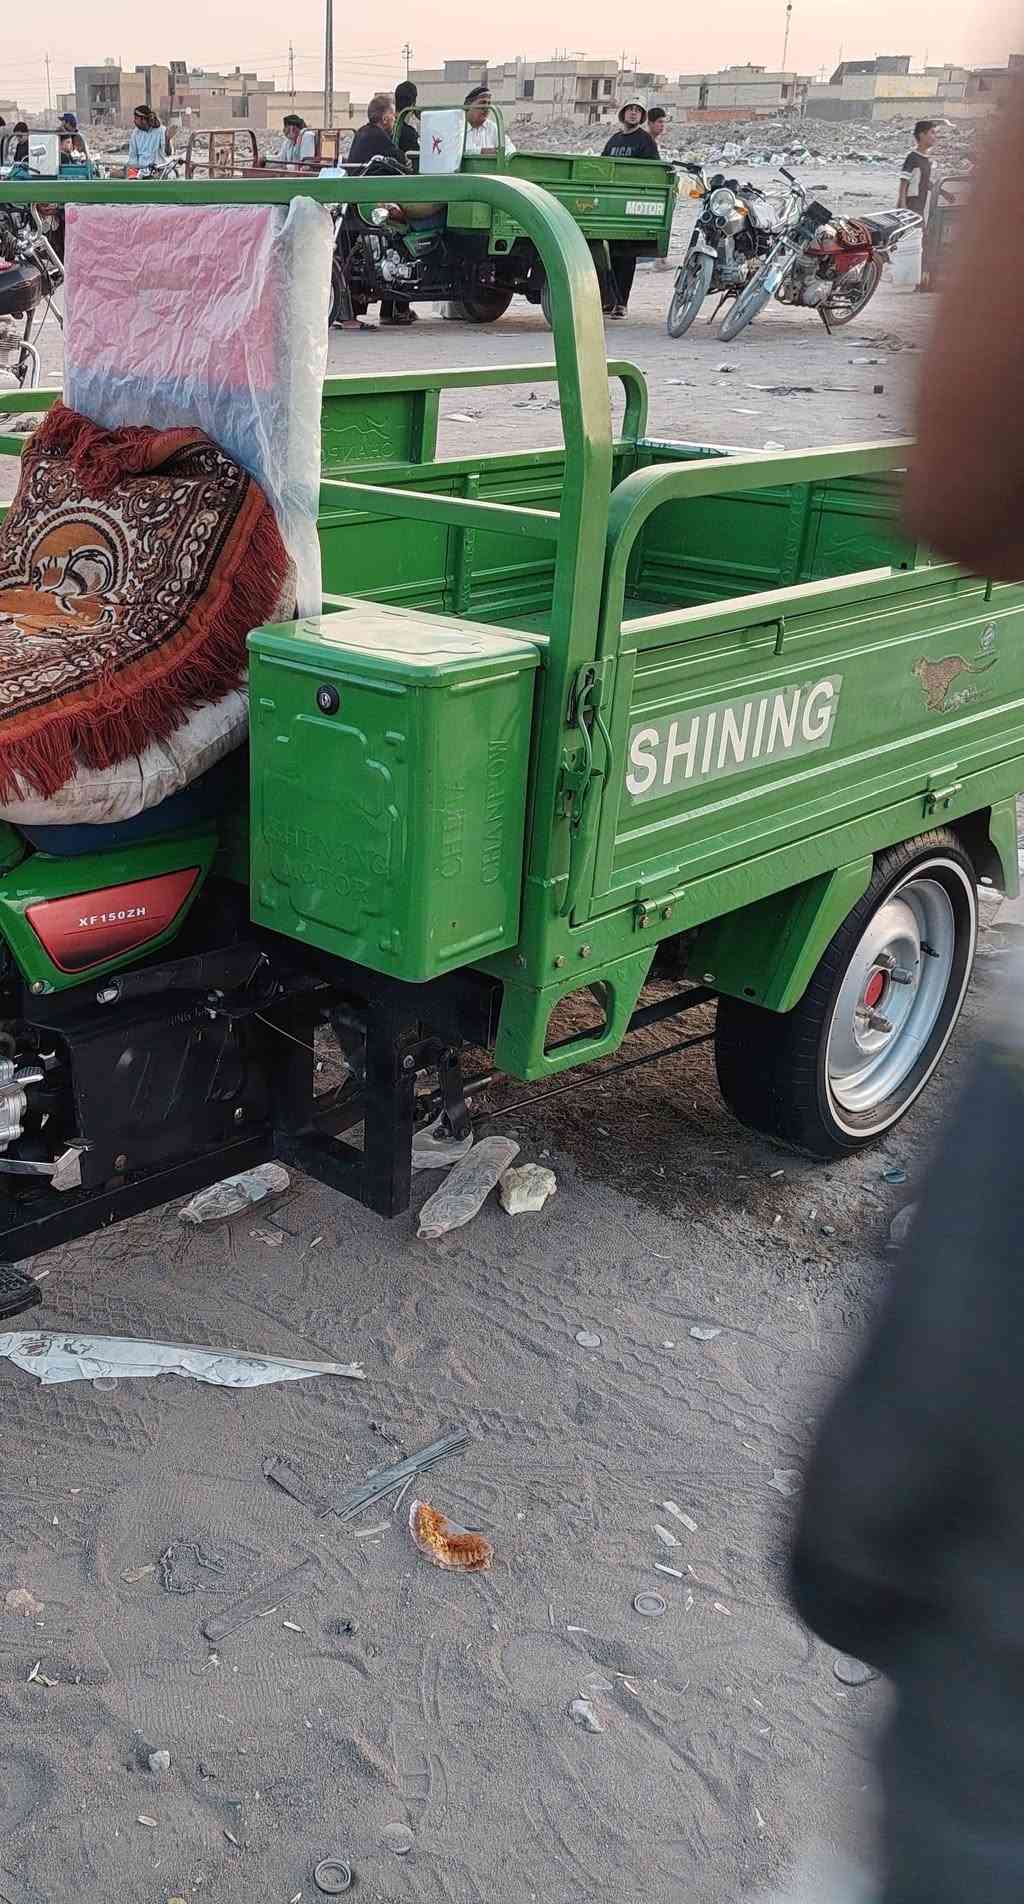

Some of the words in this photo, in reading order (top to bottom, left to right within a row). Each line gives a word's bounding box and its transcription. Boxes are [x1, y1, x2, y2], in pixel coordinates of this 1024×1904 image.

[626, 201, 664, 215] MOTOR
[626, 681, 834, 795] SHINING
[79, 907, 146, 927] XF150ZH
